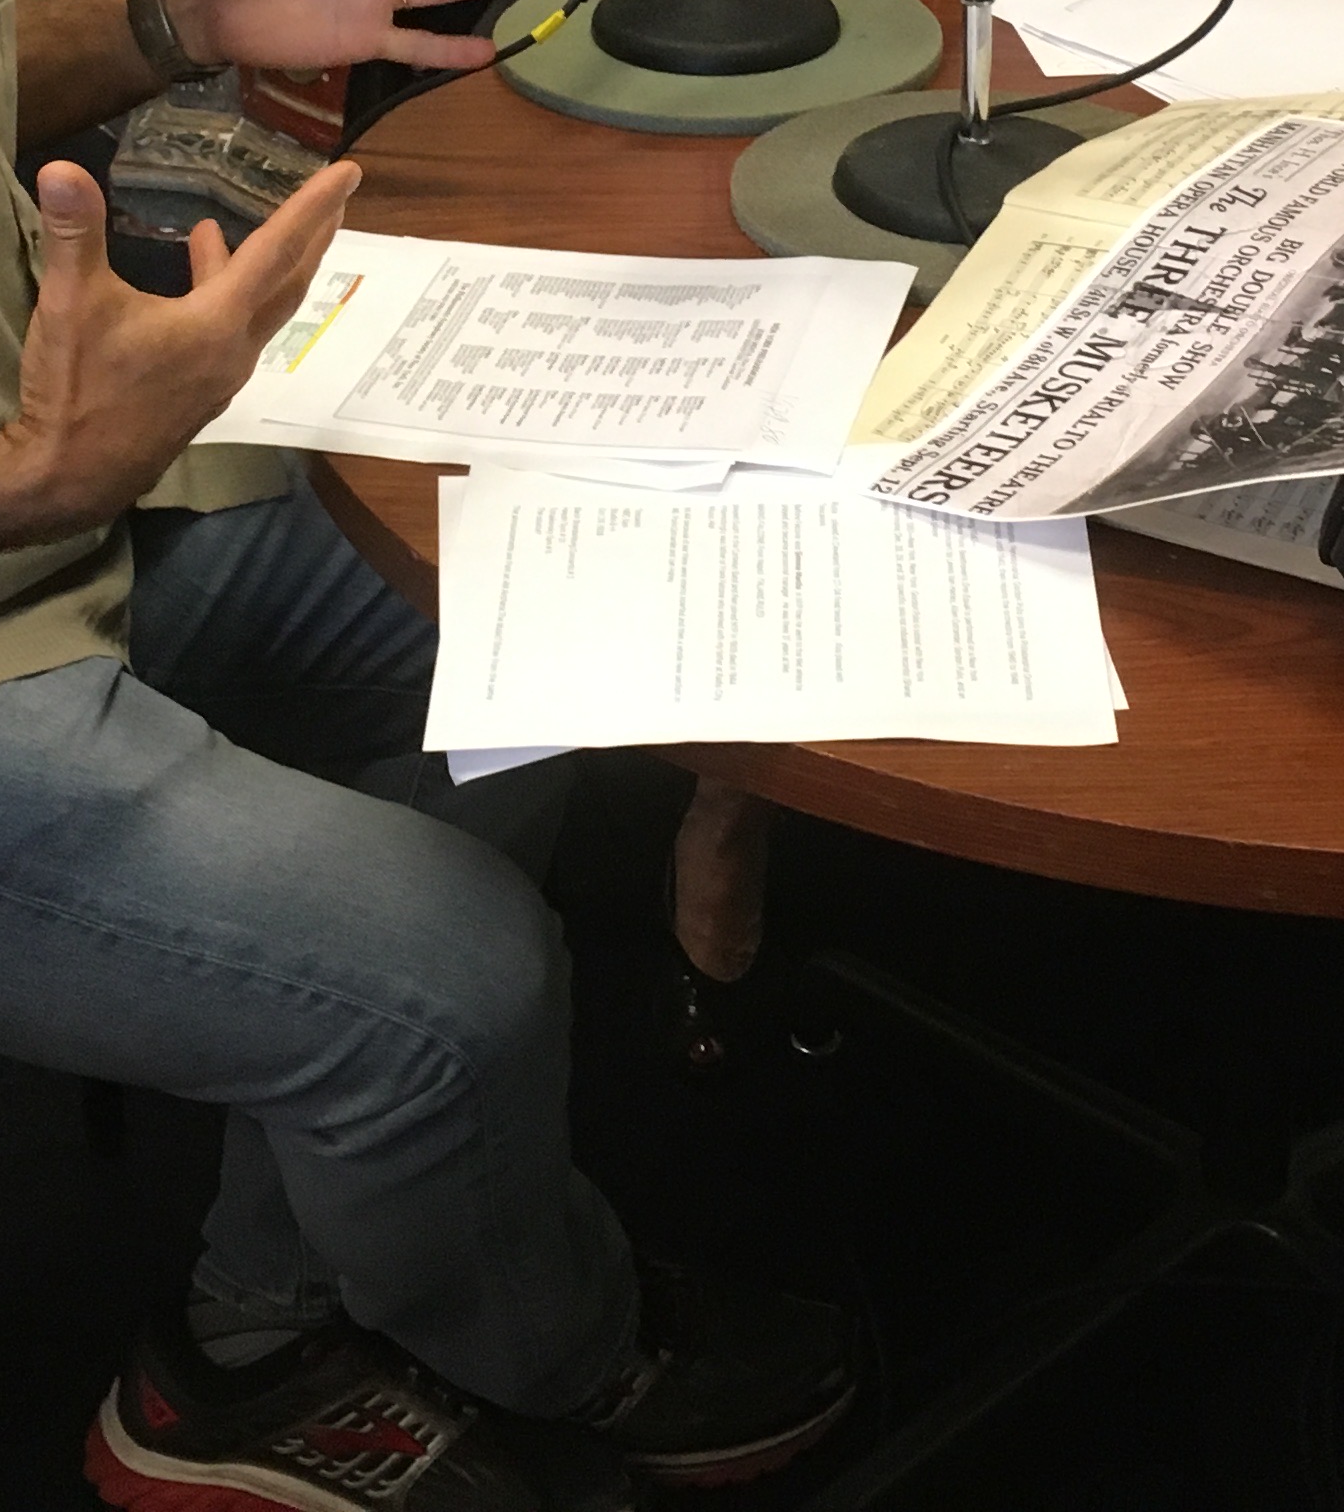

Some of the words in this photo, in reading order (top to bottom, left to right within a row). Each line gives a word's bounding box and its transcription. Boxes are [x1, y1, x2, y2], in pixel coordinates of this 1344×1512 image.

[1207, 121, 1300, 180] MANHATTAN
[1154, 180, 1214, 219] OPERA
[1209, 184, 1267, 215] The
[1249, 193, 1317, 244] FAMOUS
[1100, 222, 1166, 278] HOUSE,
[1265, 238, 1303, 264] BIG
[1077, 287, 1108, 310] 4th
[1108, 228, 1226, 325] THREE
[1167, 244, 1260, 338] ORCHESTRA
[1206, 268, 1273, 335] DOUBLE
[1156, 341, 1213, 392] SHOW
[906, 330, 1127, 506] MUSKETEERS
[927, 398, 998, 448] Starting
[1051, 392, 1123, 452] RIALTO
[891, 448, 939, 472] Sept.
[968, 450, 1062, 516] THEATRE
[870, 478, 900, 494] 12
